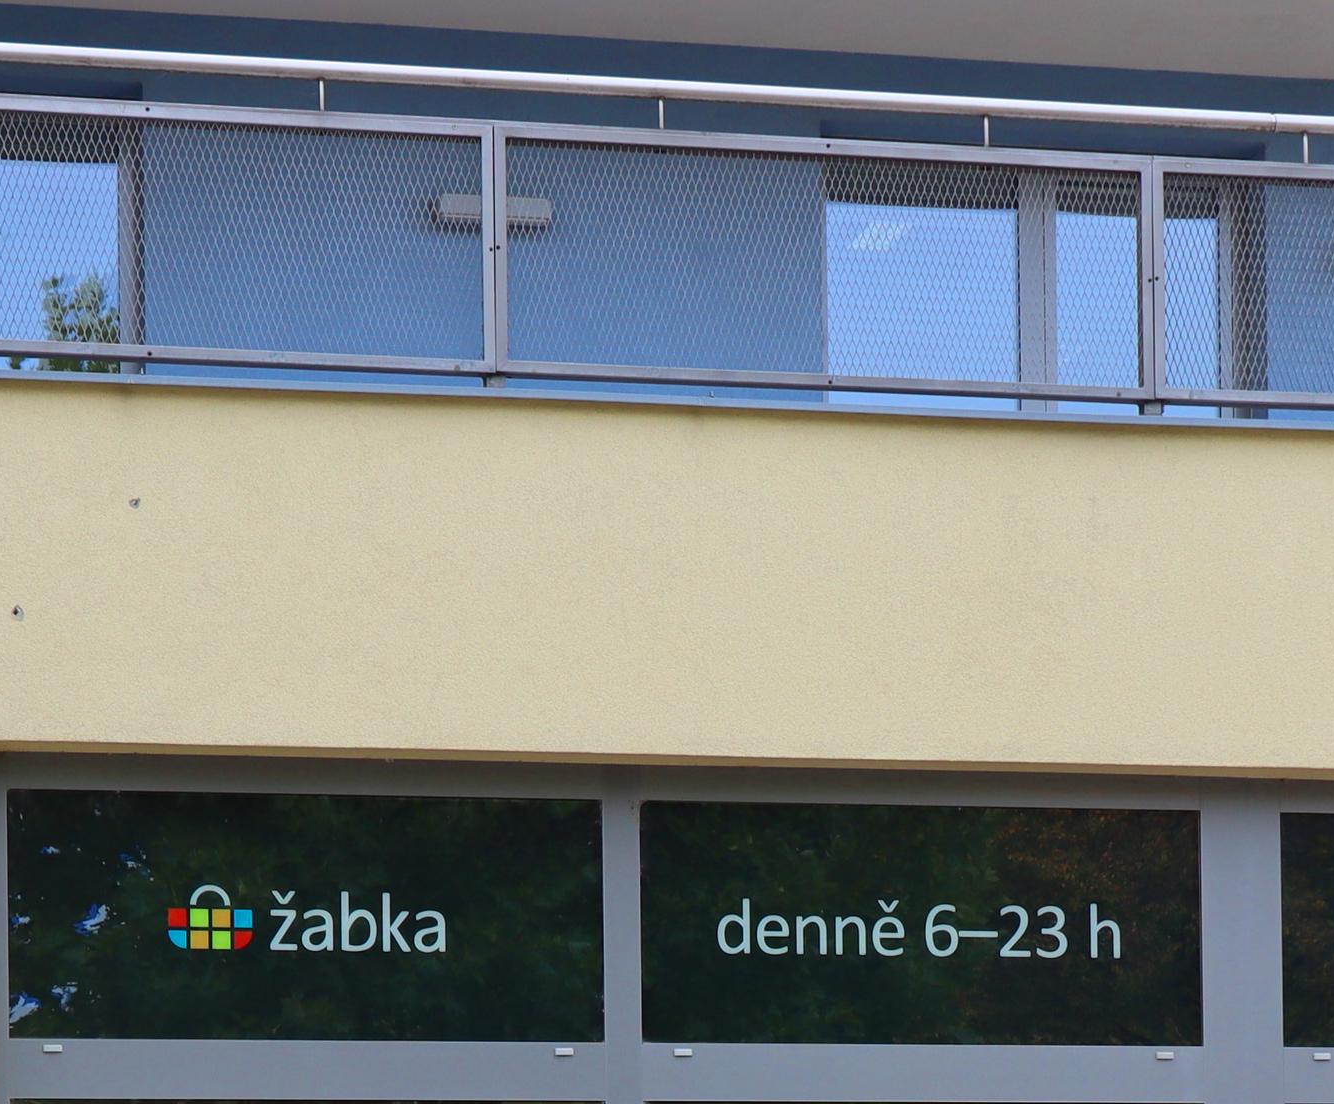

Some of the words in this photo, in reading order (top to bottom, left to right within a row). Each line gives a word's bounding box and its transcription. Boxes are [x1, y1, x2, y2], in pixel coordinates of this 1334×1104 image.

[269, 889, 447, 953] žabka
[717, 897, 905, 957] denně
[924, 904, 1068, 958] 6–23
[1090, 903, 1122, 957] h
